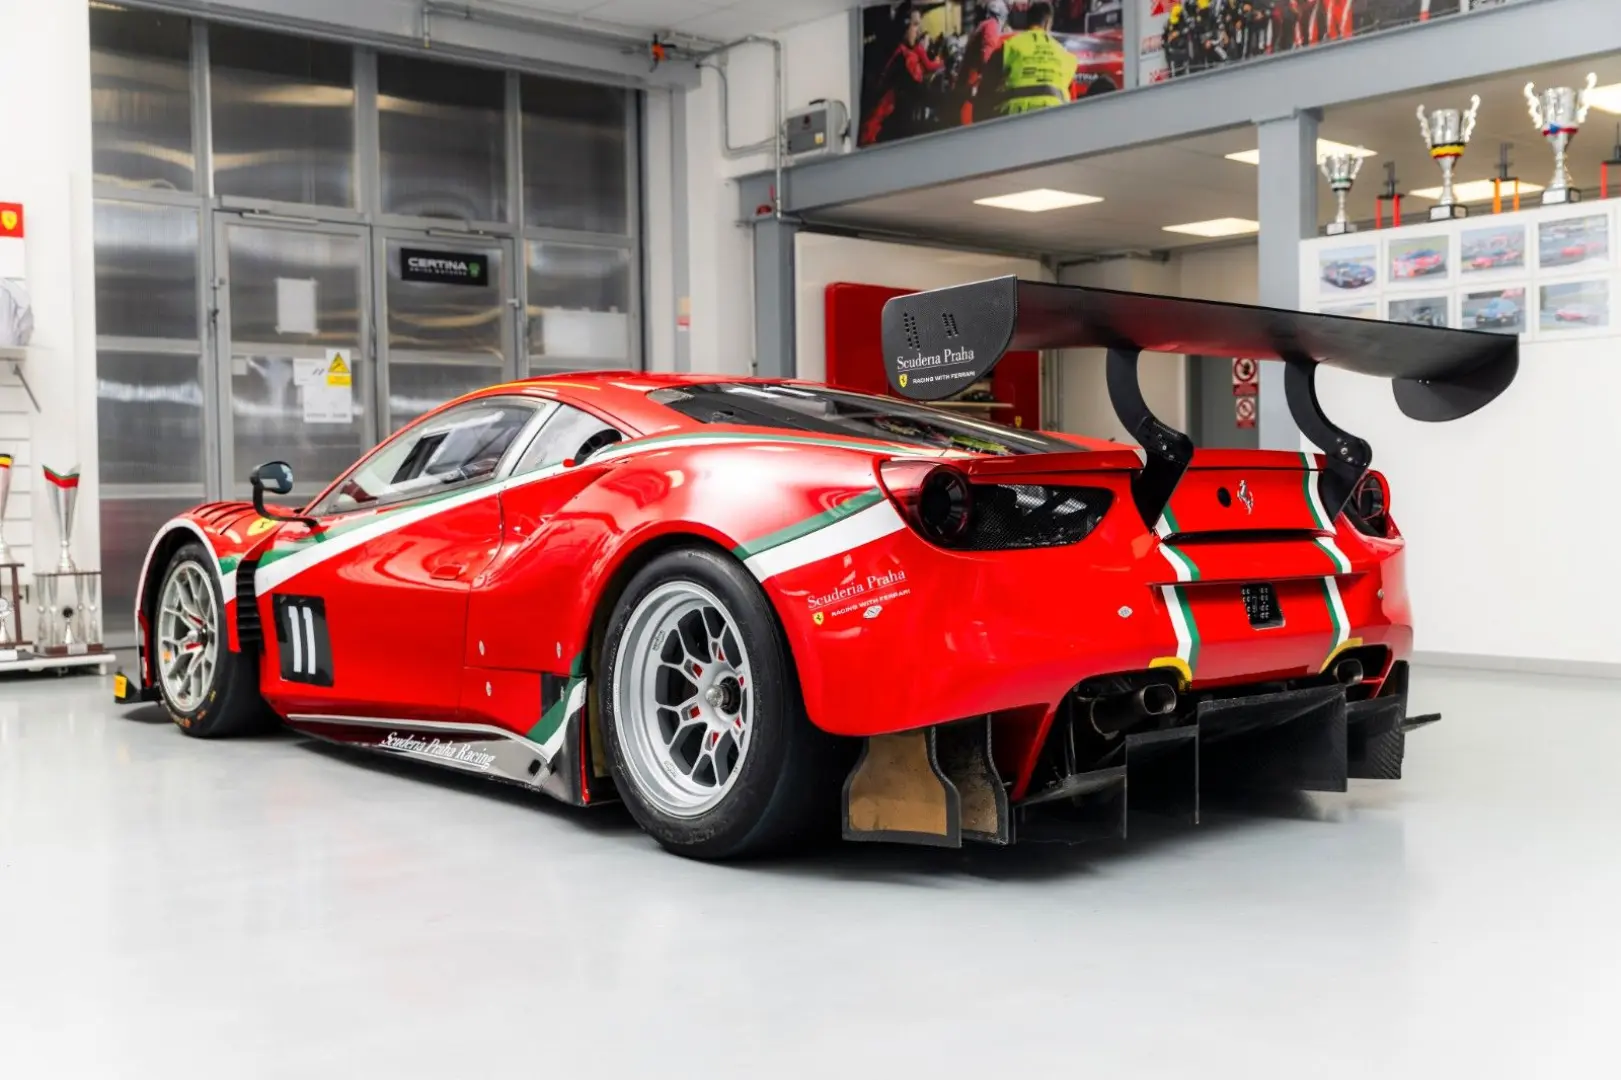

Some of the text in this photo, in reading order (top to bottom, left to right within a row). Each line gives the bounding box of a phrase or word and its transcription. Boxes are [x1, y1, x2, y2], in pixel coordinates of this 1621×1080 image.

[408, 257, 468, 271] CERTINA
[896, 346, 975, 370] Scuderia Praha
[912, 370, 976, 385] RACING WITH FERRARI
[807, 569, 907, 610] Scuderia Praha
[831, 604, 858, 617] RACING
[859, 598, 880, 609] WITH
[879, 588, 911, 603] FERRARI
[287, 605, 317, 675] 11
[380, 731, 496, 771] Scuderia Praha Racing
